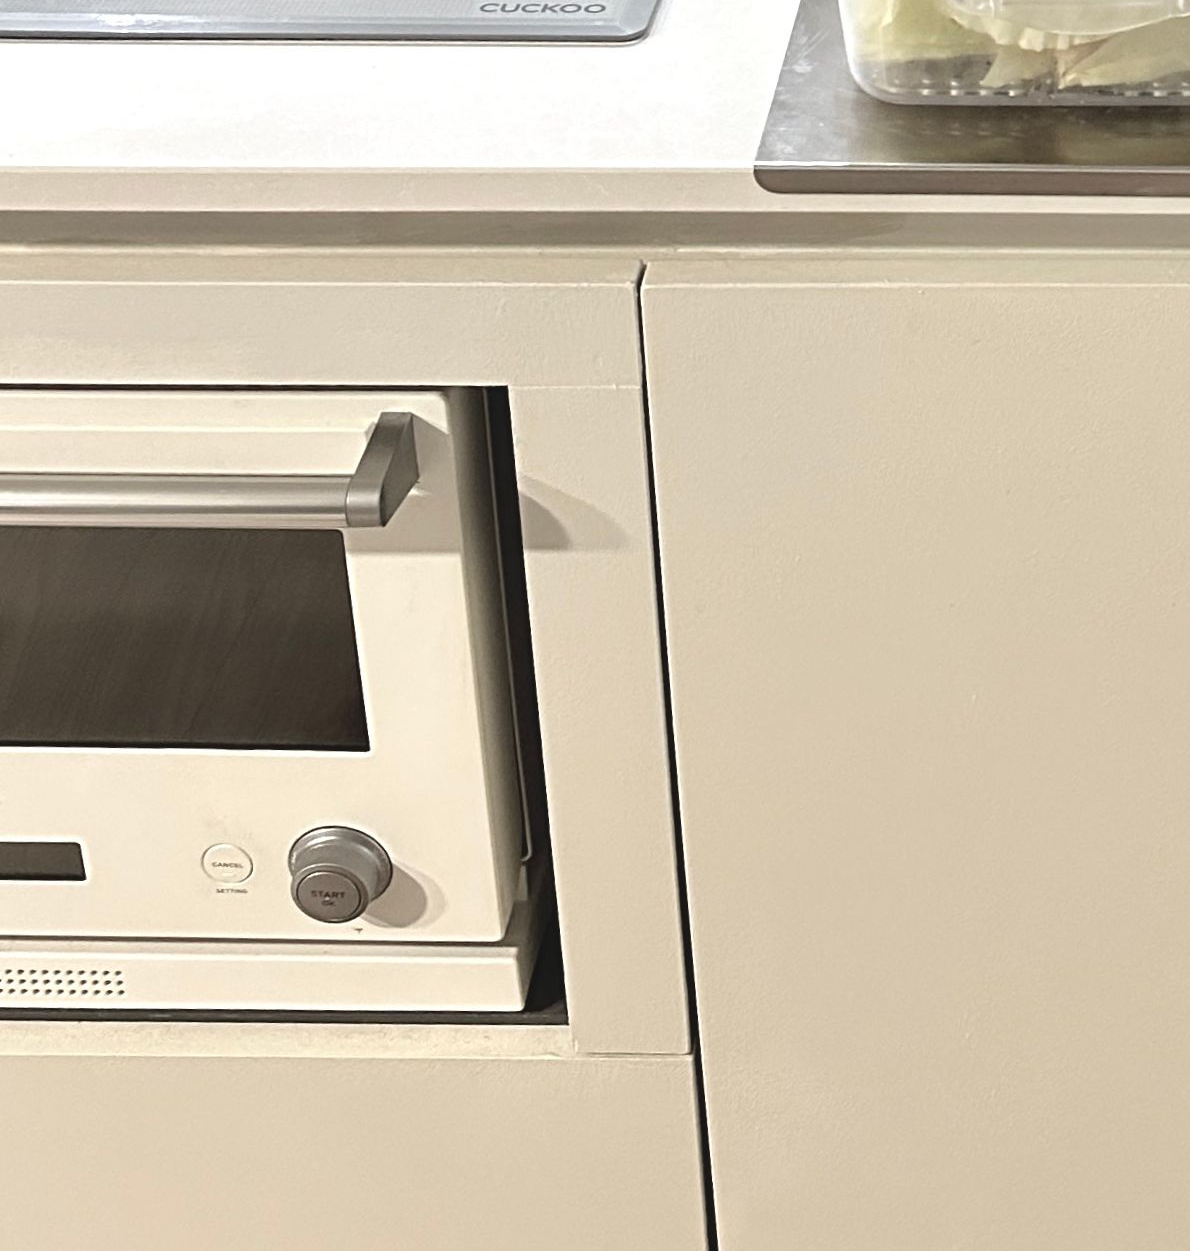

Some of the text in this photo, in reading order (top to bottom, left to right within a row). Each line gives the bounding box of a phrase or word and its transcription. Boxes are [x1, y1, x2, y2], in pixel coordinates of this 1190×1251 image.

[479, 2, 607, 14] CUCKOO
[211, 861, 244, 869] CANCEL
[311, 890, 346, 899] START
